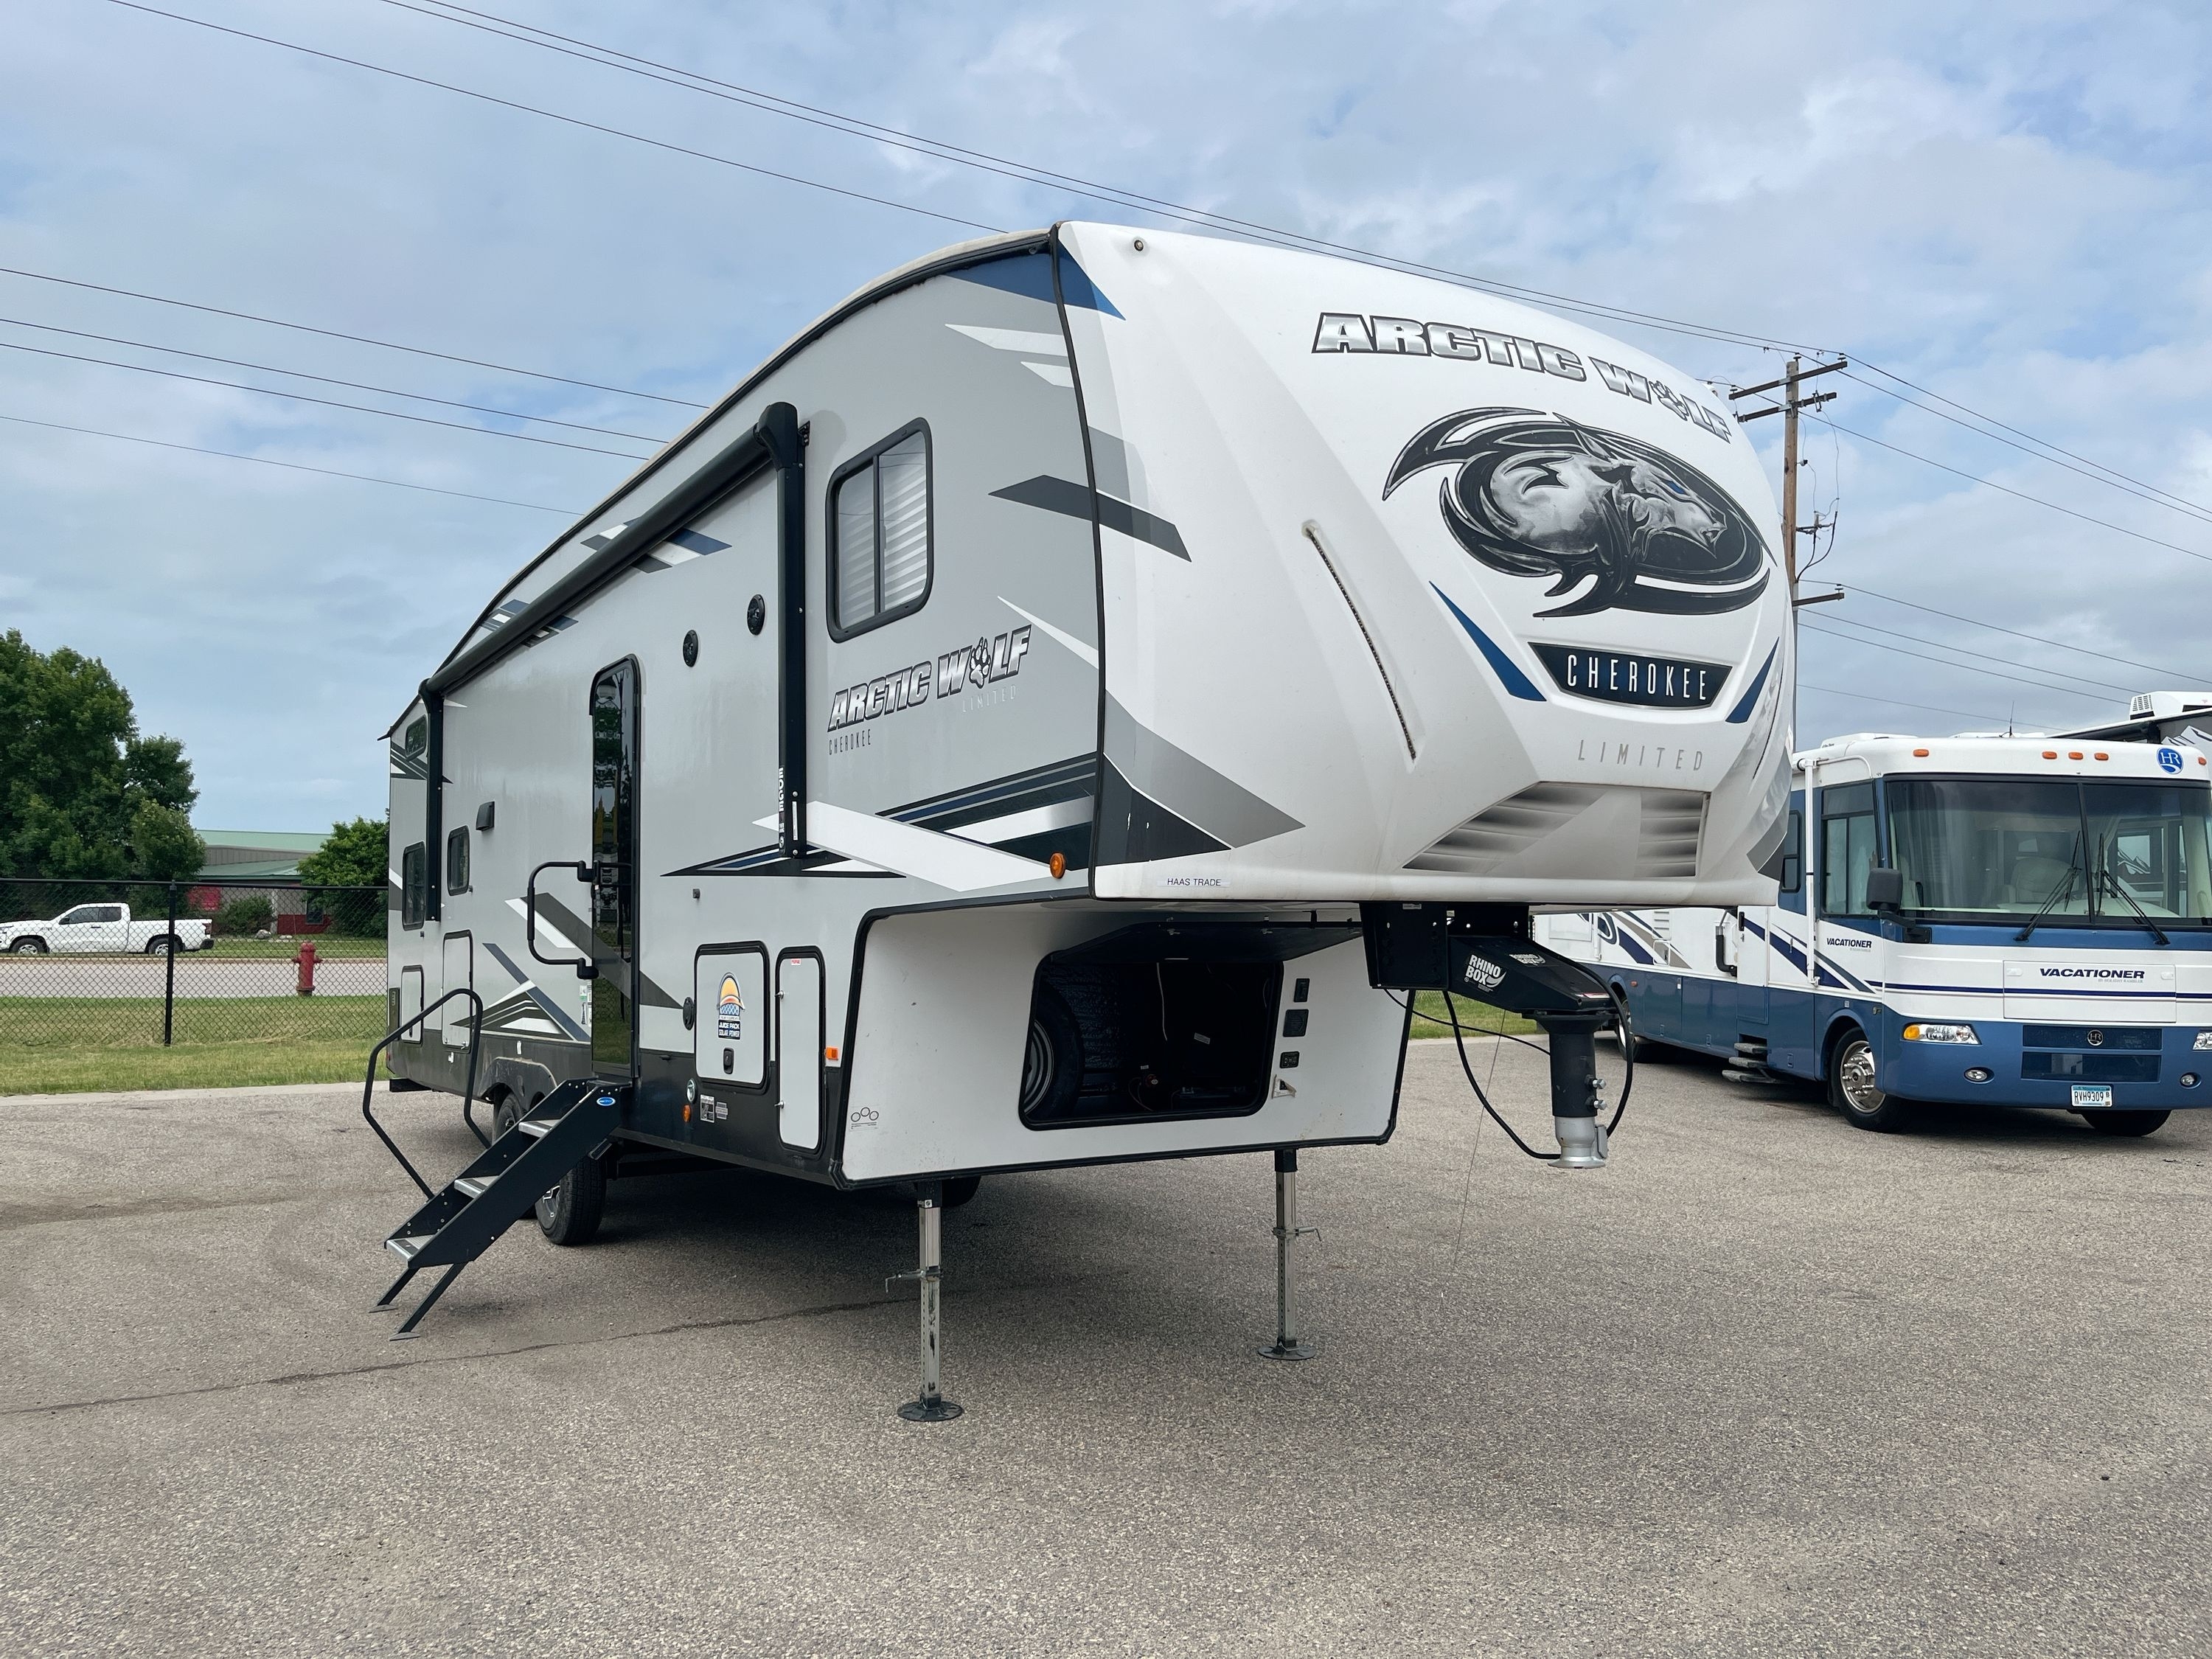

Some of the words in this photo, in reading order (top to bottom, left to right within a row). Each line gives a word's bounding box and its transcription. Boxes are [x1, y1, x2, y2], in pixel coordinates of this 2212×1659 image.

[1312, 312, 1585, 382] ARCTIC
[1565, 653, 1708, 700] CHEROKEE
[827, 660, 932, 732] ARCTIC
[962, 684, 1018, 713] LIMITED
[829, 728, 872, 755] CHEROKEE
[1577, 739, 1704, 772] LIMITED
[2160, 752, 2180, 765] HR
[1167, 878, 1191, 886] HAAS
[1193, 878, 1222, 886] TRADE
[1826, 938, 1872, 948] VACATIONER
[1465, 965, 1489, 985] BOX
[1469, 954, 1501, 978] RHINO
[2039, 968, 2145, 978] VACATIONER
[2074, 1091, 2104, 1102] RVH9309
